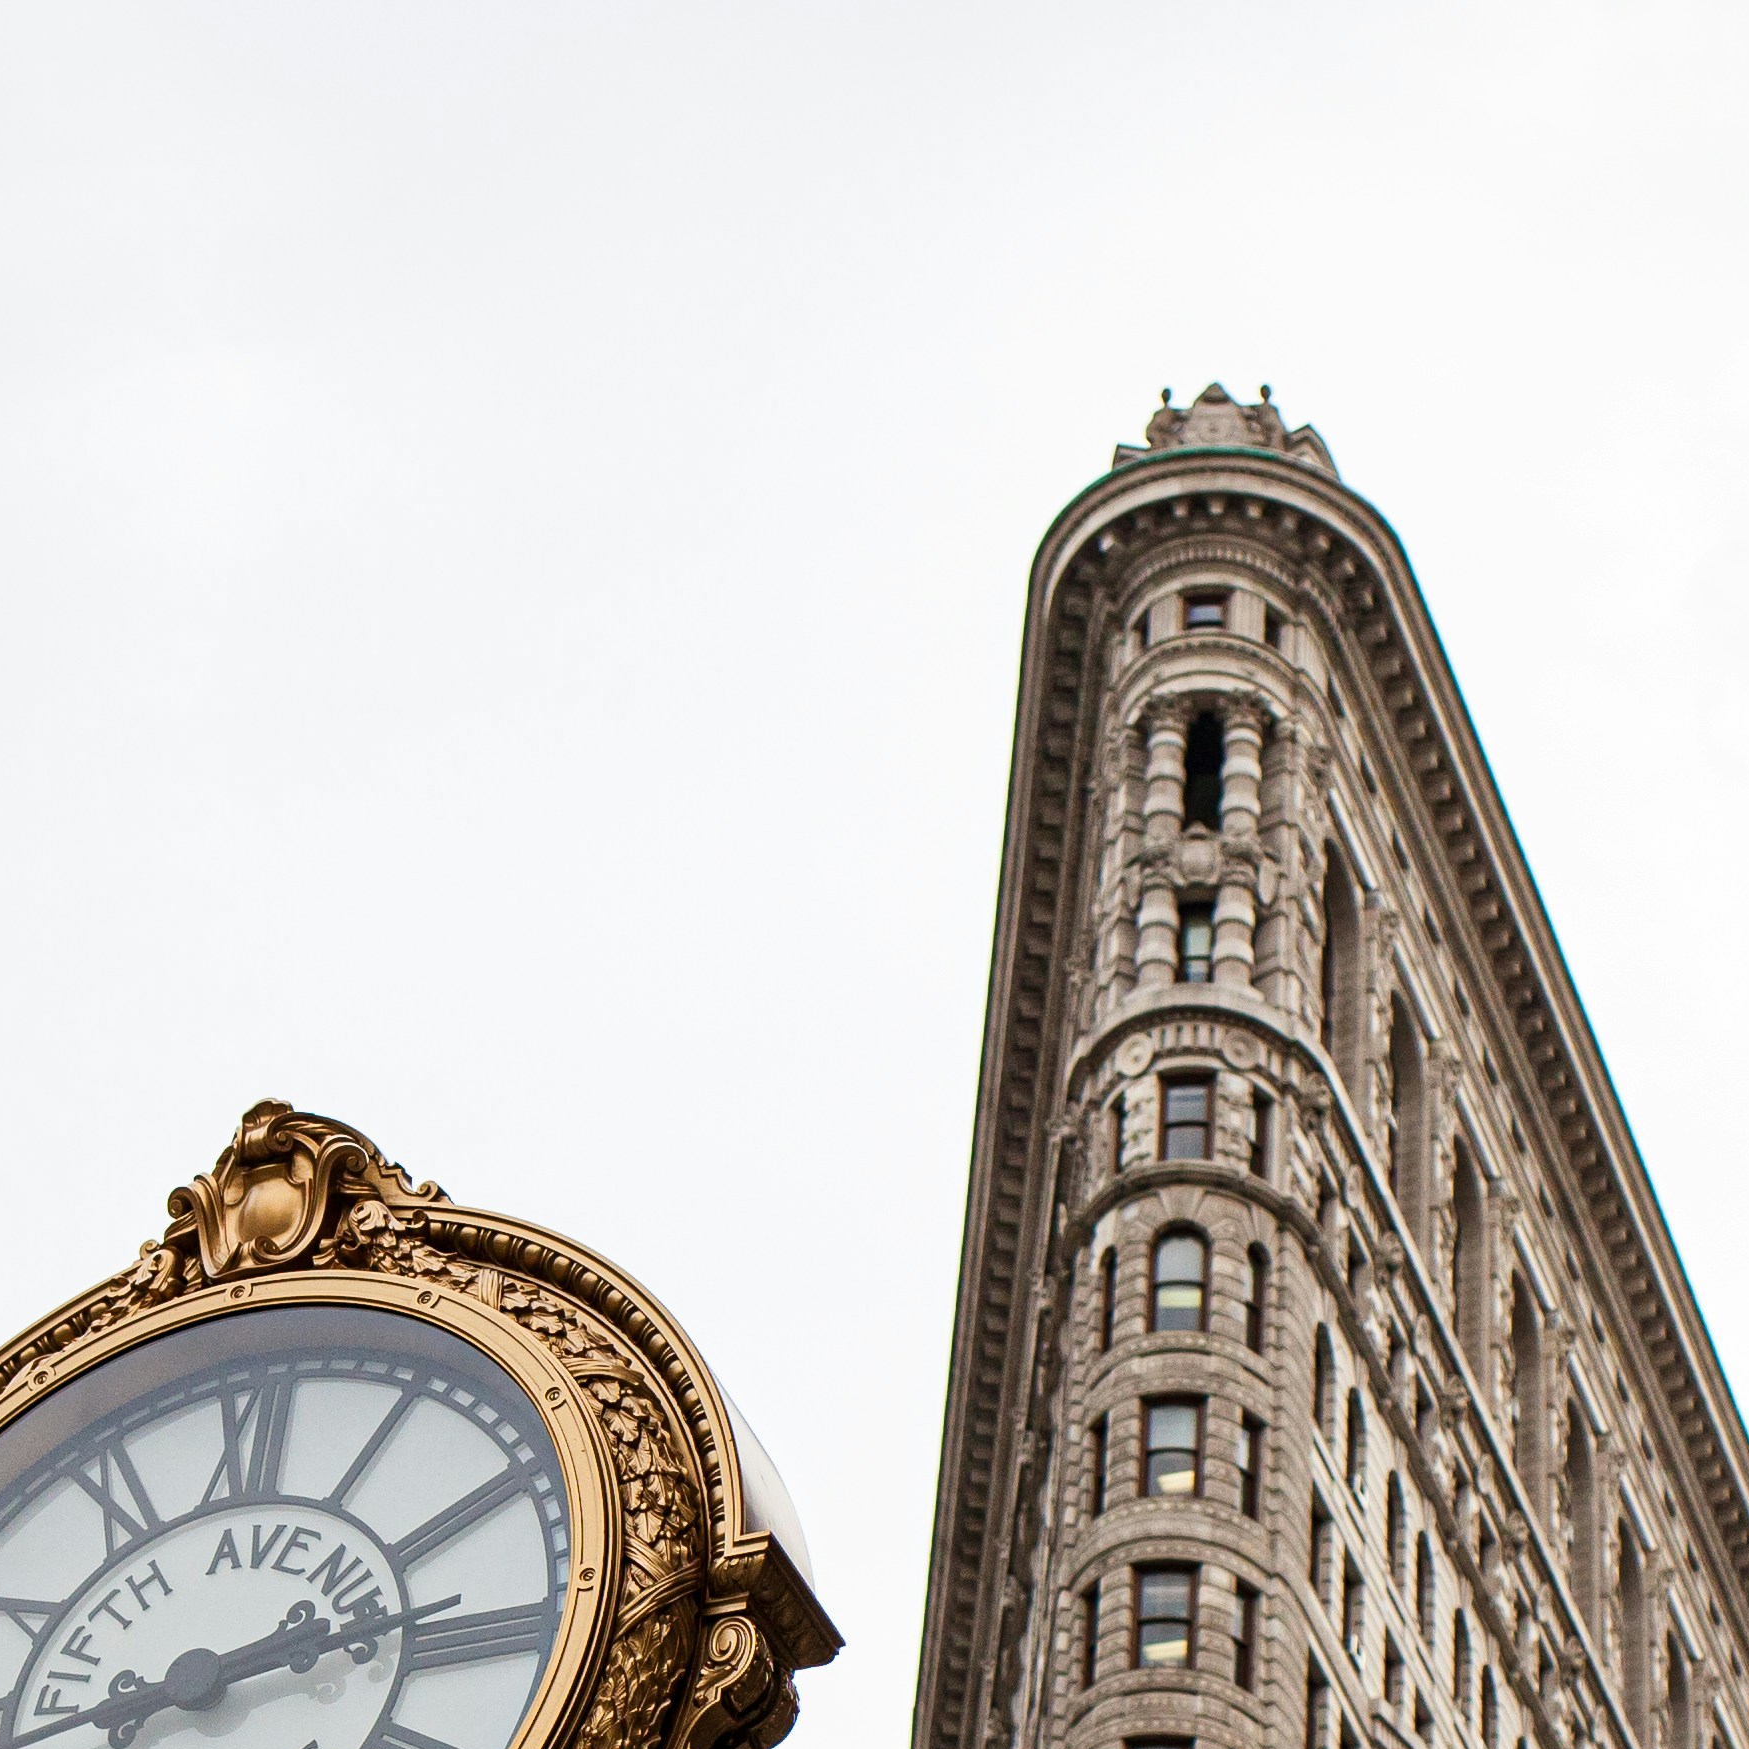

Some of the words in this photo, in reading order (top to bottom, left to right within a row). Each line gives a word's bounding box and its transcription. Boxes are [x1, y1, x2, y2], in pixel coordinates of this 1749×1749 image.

[59, 1432, 167, 1564] XI
[194, 1378, 296, 1510] XII
[323, 1386, 421, 1507] I
[388, 1460, 531, 1571] II
[34, 1559, 173, 1717] FIFTH
[205, 1524, 389, 1620] AVENU
[402, 1597, 549, 1677] III
